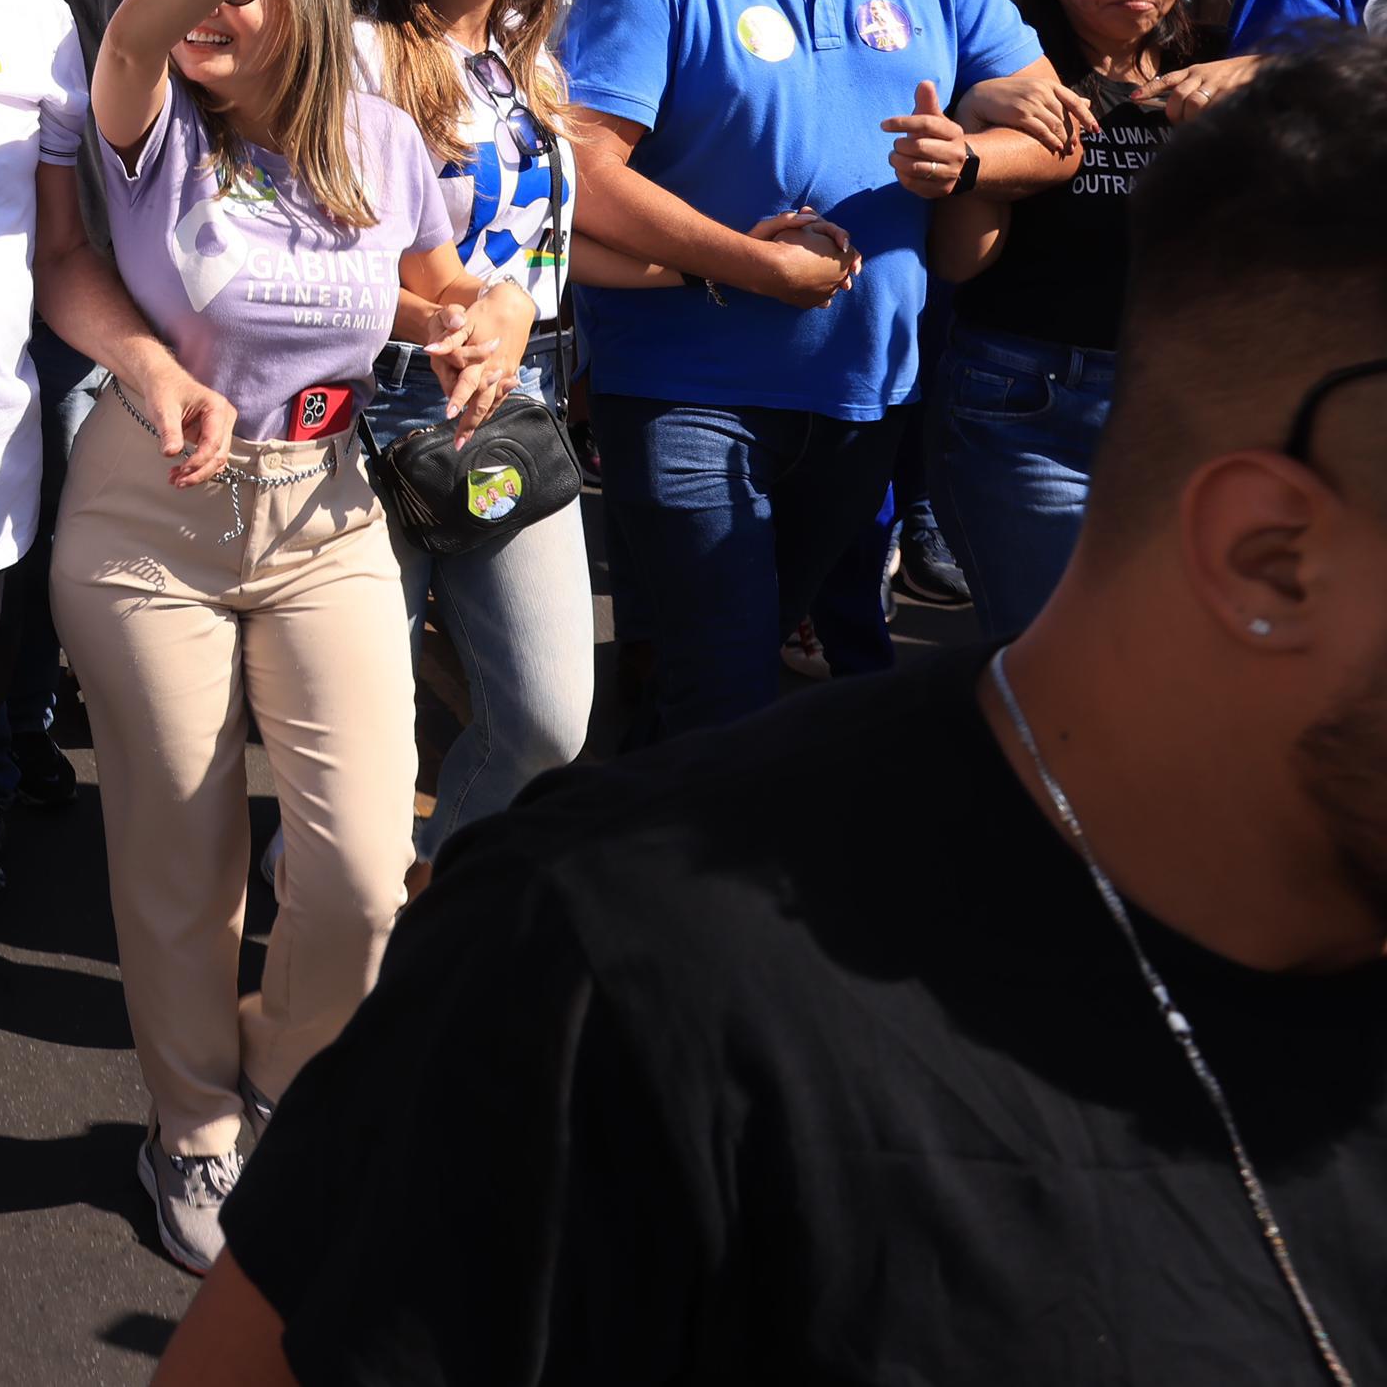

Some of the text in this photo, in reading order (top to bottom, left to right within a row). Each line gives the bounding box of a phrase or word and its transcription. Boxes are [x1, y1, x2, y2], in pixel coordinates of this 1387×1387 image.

[1112, 127, 1157, 144] UMA
[1081, 149, 1110, 169] UE
[246, 279, 400, 310] ITINERAN
